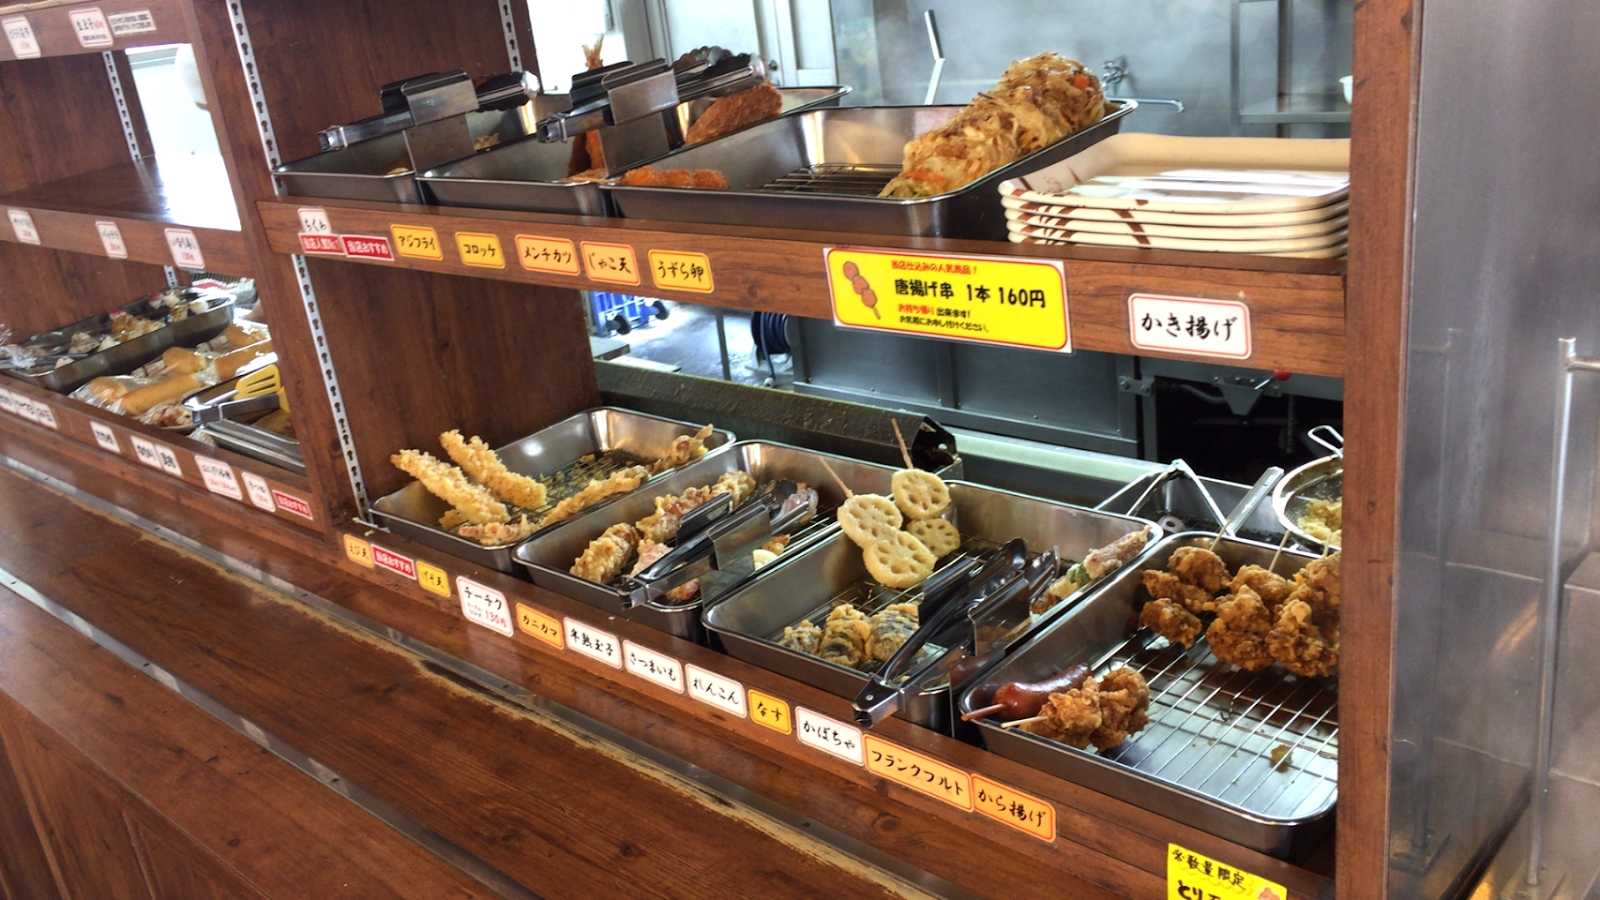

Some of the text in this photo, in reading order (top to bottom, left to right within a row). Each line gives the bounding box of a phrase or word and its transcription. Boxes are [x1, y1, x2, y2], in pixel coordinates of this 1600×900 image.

[397, 234, 437, 252] アジフライ
[463, 242, 497, 259] コロッケ
[523, 246, 572, 266] メンチカツ
[589, 252, 631, 275] じゃこ天
[655, 260, 705, 283] うずら卵
[894, 278, 1046, 308] 唐揚げ串 1本 160円
[1140, 312, 1238, 343] かき揚げ
[464, 585, 503, 611] チーチク
[522, 614, 558, 637] カニカマ
[569, 626, 614, 658] 半熟玉子
[629, 651, 678, 683] さつまいも
[692, 676, 740, 706] れんこん
[756, 700, 785, 722] なす
[802, 719, 857, 750] かぼちゃ
[870, 748, 964, 797] フランクフルト
[977, 787, 1047, 828] から揚げ
[1177, 879, 1222, 900] とり
